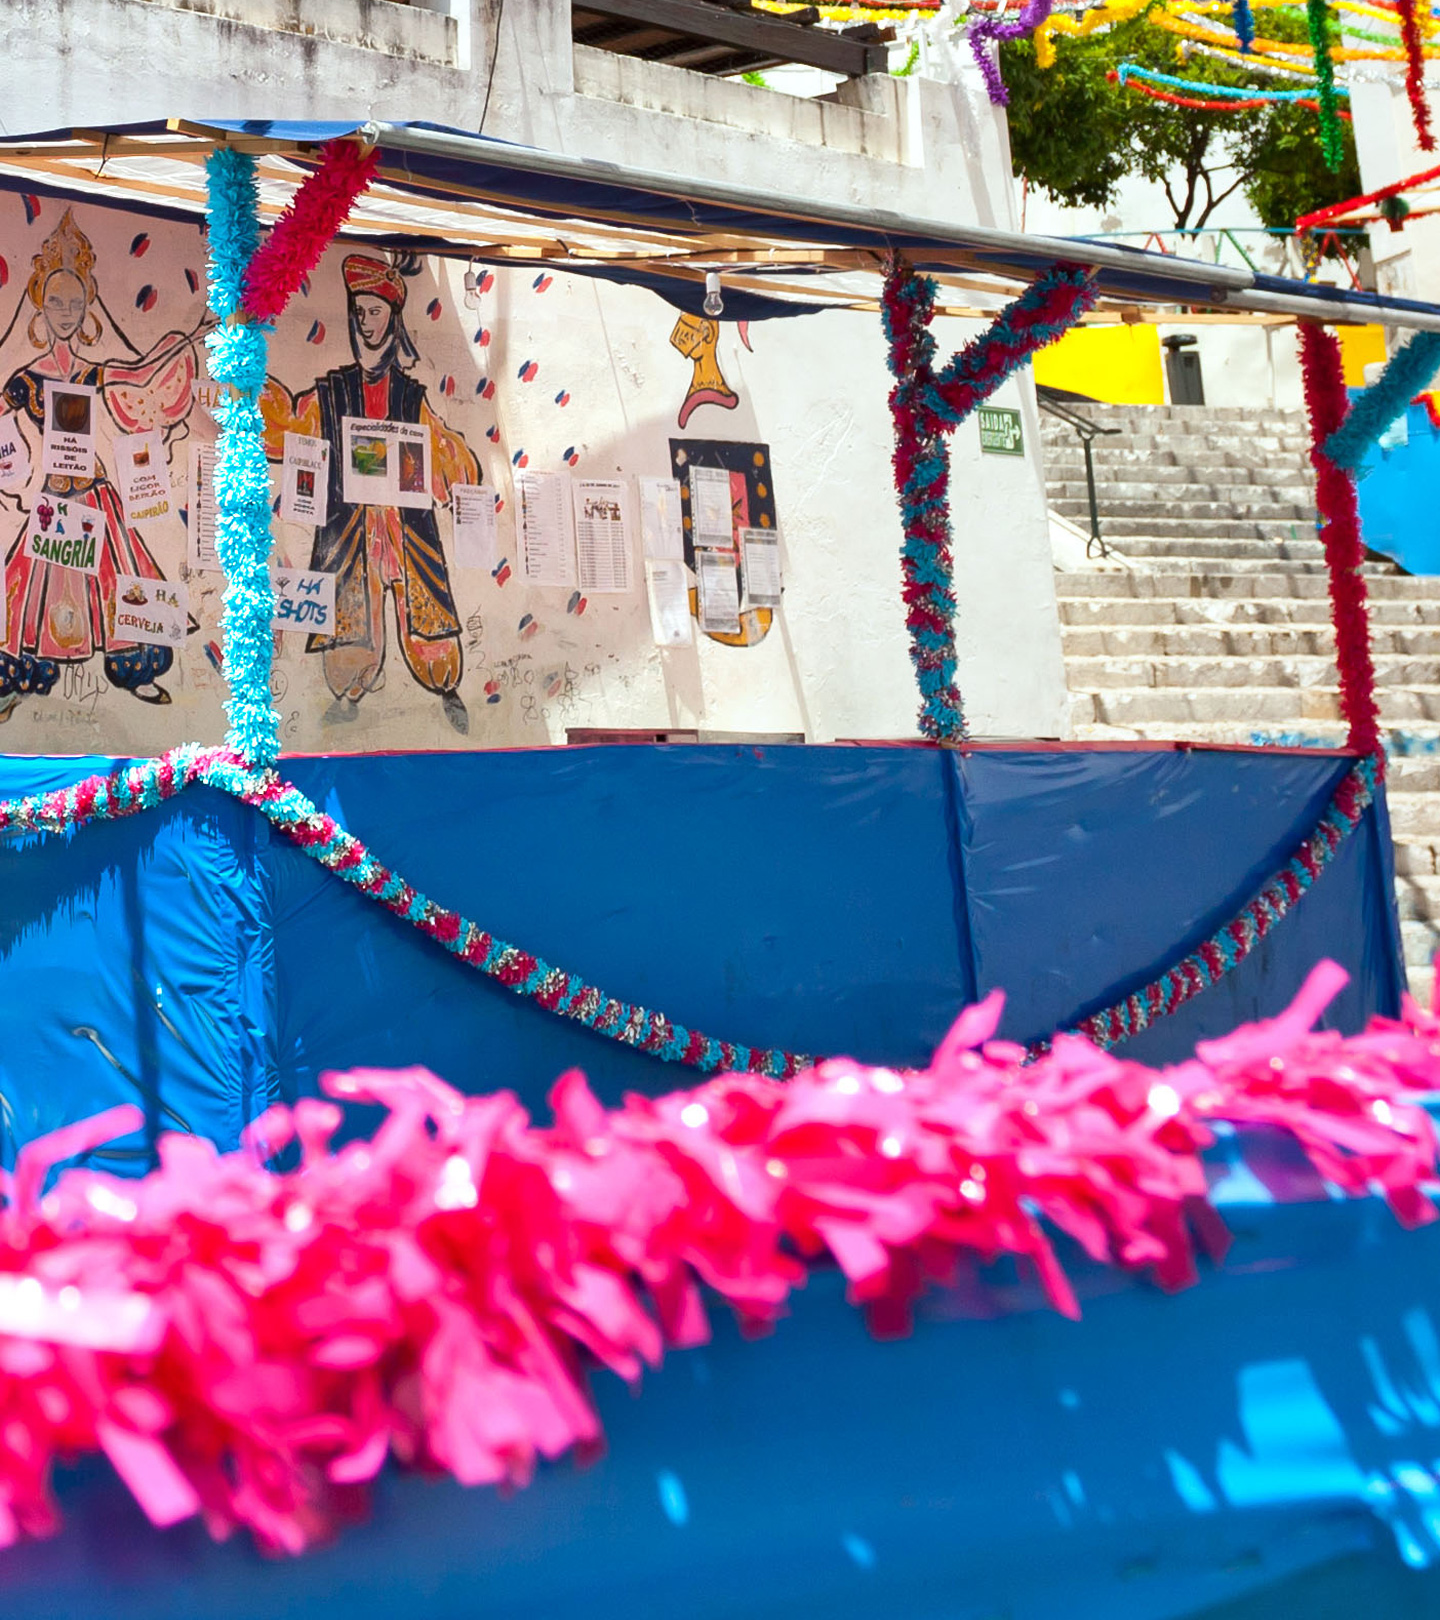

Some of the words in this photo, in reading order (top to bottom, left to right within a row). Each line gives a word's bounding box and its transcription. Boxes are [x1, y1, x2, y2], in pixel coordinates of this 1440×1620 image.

[53, 461, 87, 472] LEITÃO
[64, 454, 77, 462] DE
[133, 474, 156, 484] COM
[31, 533, 97, 569] SANGRIA
[297, 577, 325, 596] HÁ
[277, 598, 327, 626] SHOTS
[117, 613, 164, 634] CERVEJA
